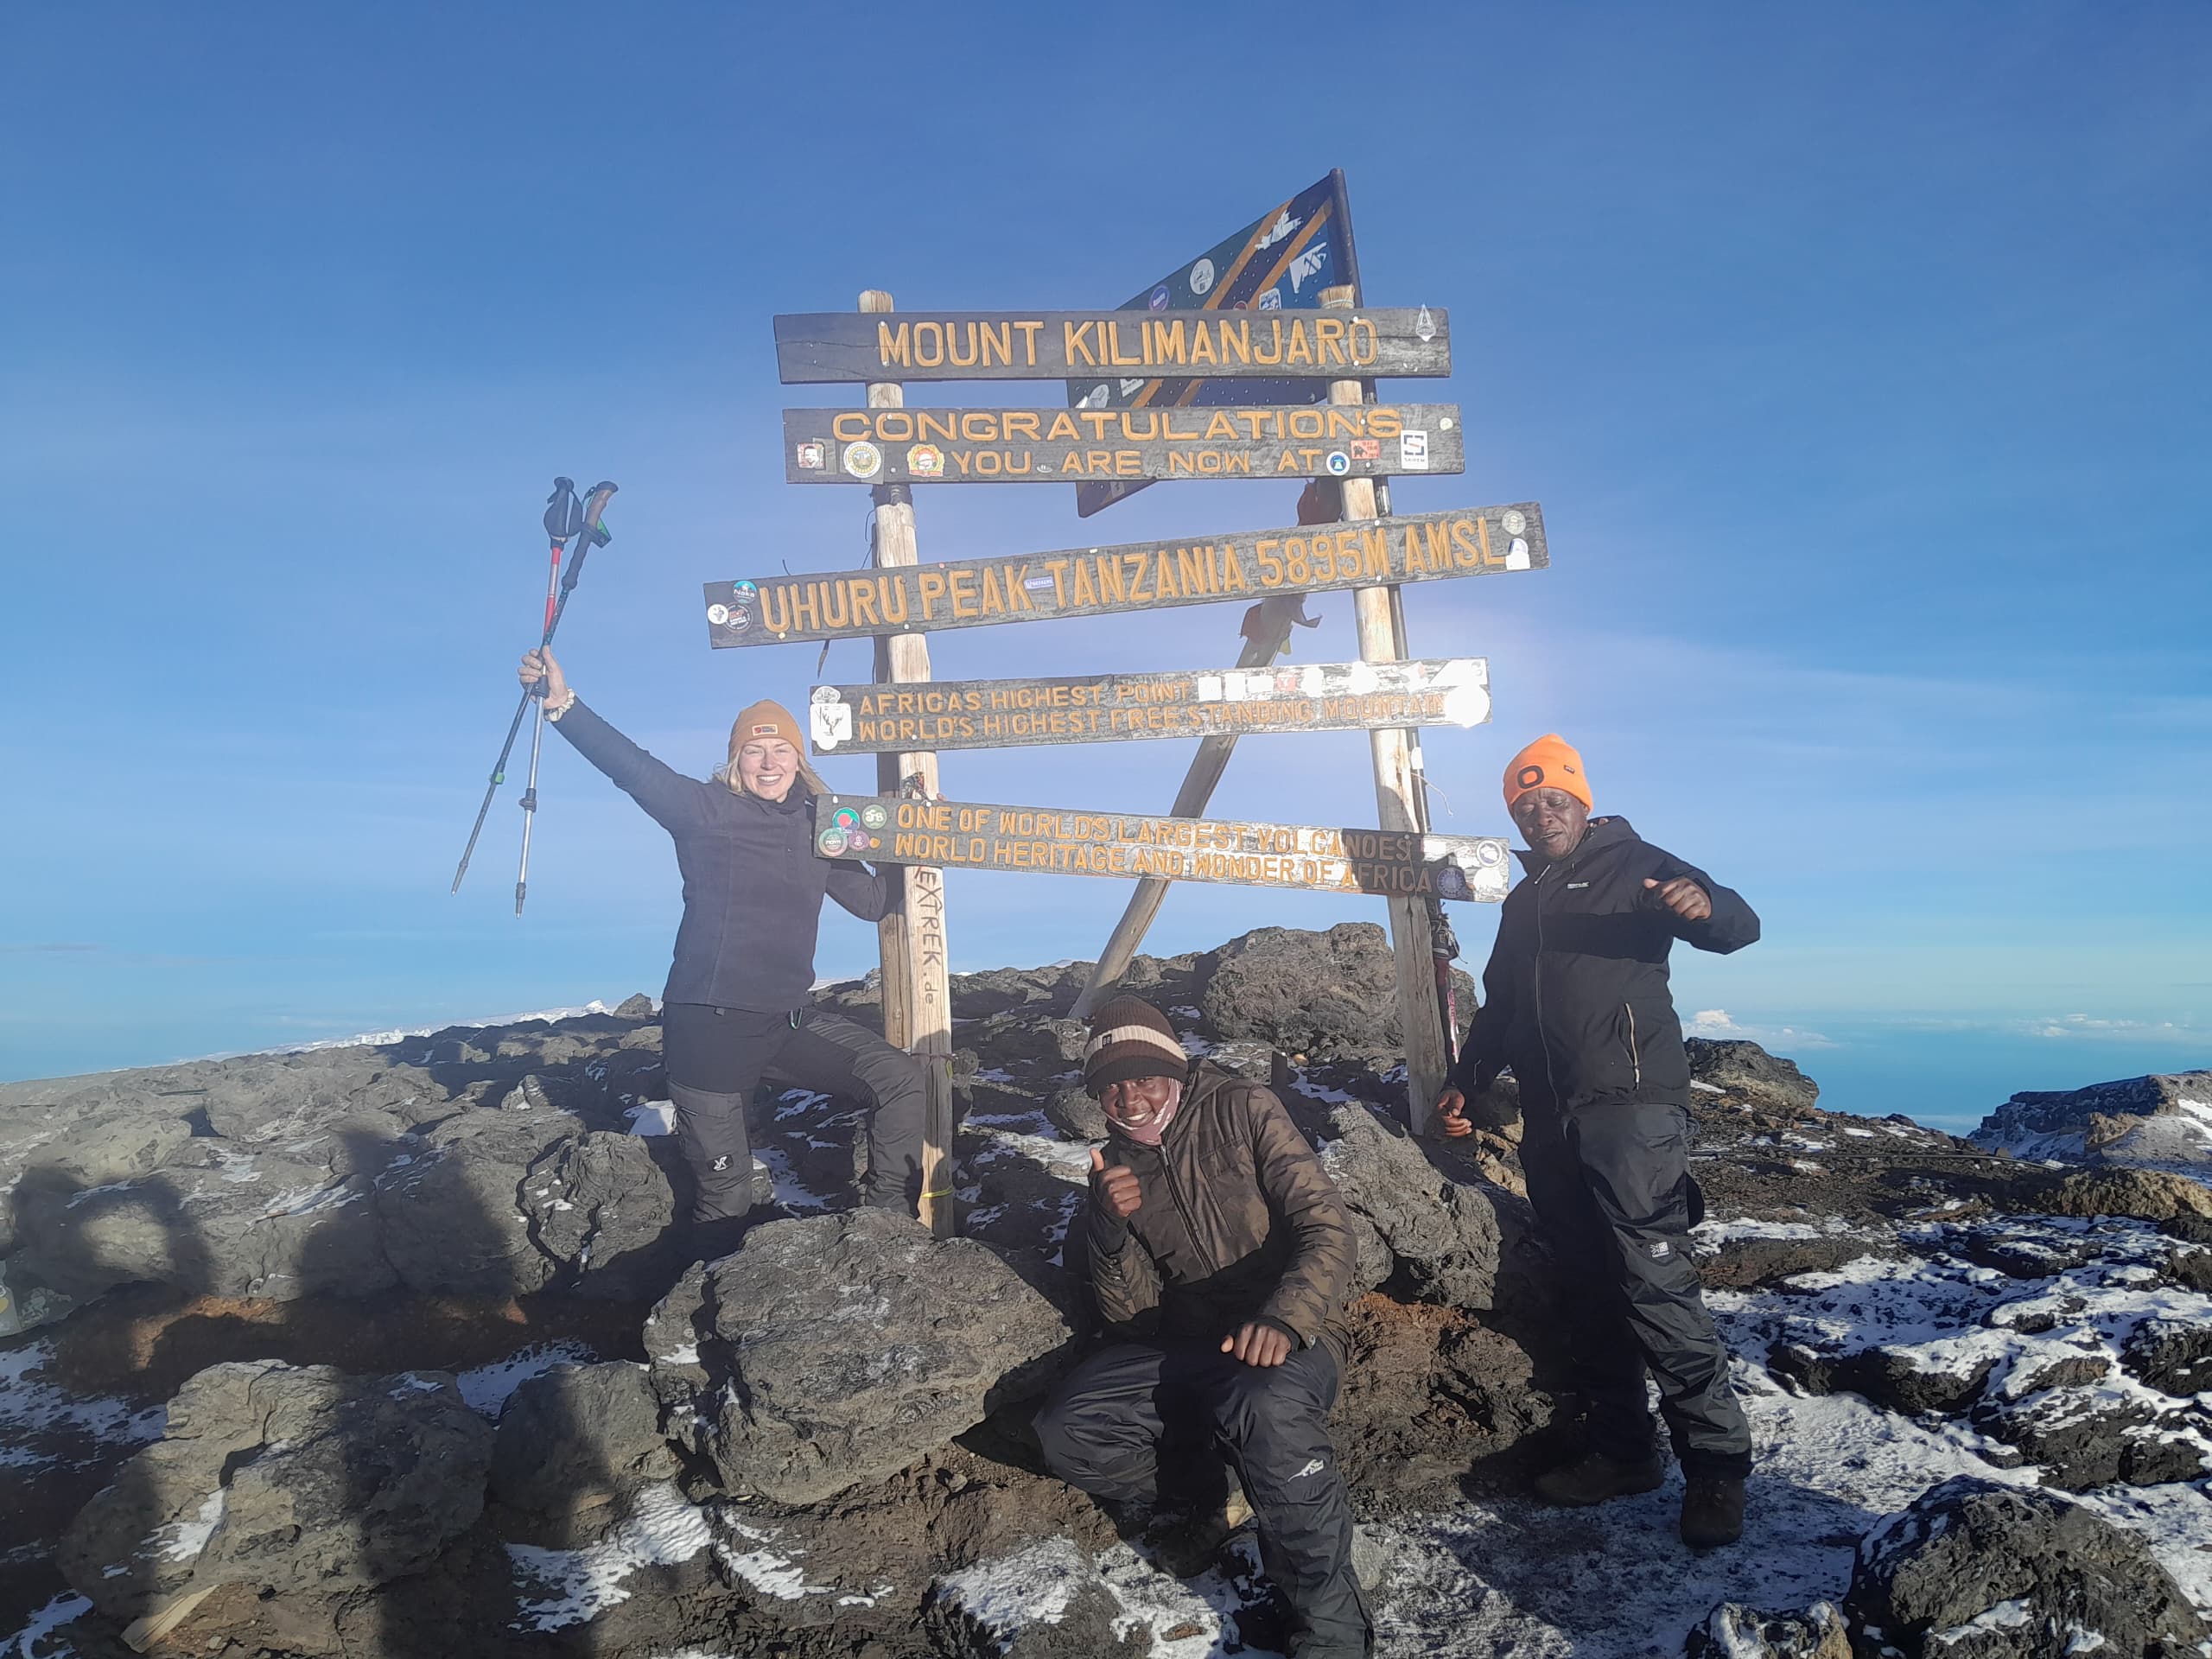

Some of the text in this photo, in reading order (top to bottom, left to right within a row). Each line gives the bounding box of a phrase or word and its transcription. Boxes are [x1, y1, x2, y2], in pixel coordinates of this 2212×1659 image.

[878, 318, 1378, 367] MOUNT KILIMANJARO
[832, 409, 1403, 442] CONGRATULATIONS
[951, 448, 1324, 475] YOU ARE NOW AT
[759, 573, 910, 633] UHURU
[1255, 527, 1391, 588] 5895M
[1404, 516, 1506, 574] AMSL
[859, 692, 1446, 742] WORLD'S HIGHEST FREE STANDING MOUNTAIN
[990, 685, 1103, 711] HIGHEST
[1116, 680, 1192, 703] POINT
[898, 804, 952, 831] ONE
[959, 809, 993, 833] OF
[1117, 818, 1249, 850] LARGEST
[1256, 827, 1413, 861] VOLCANOES
[895, 832, 1433, 893] WORLD HERITAGE AND WONDER OF AFRICA
